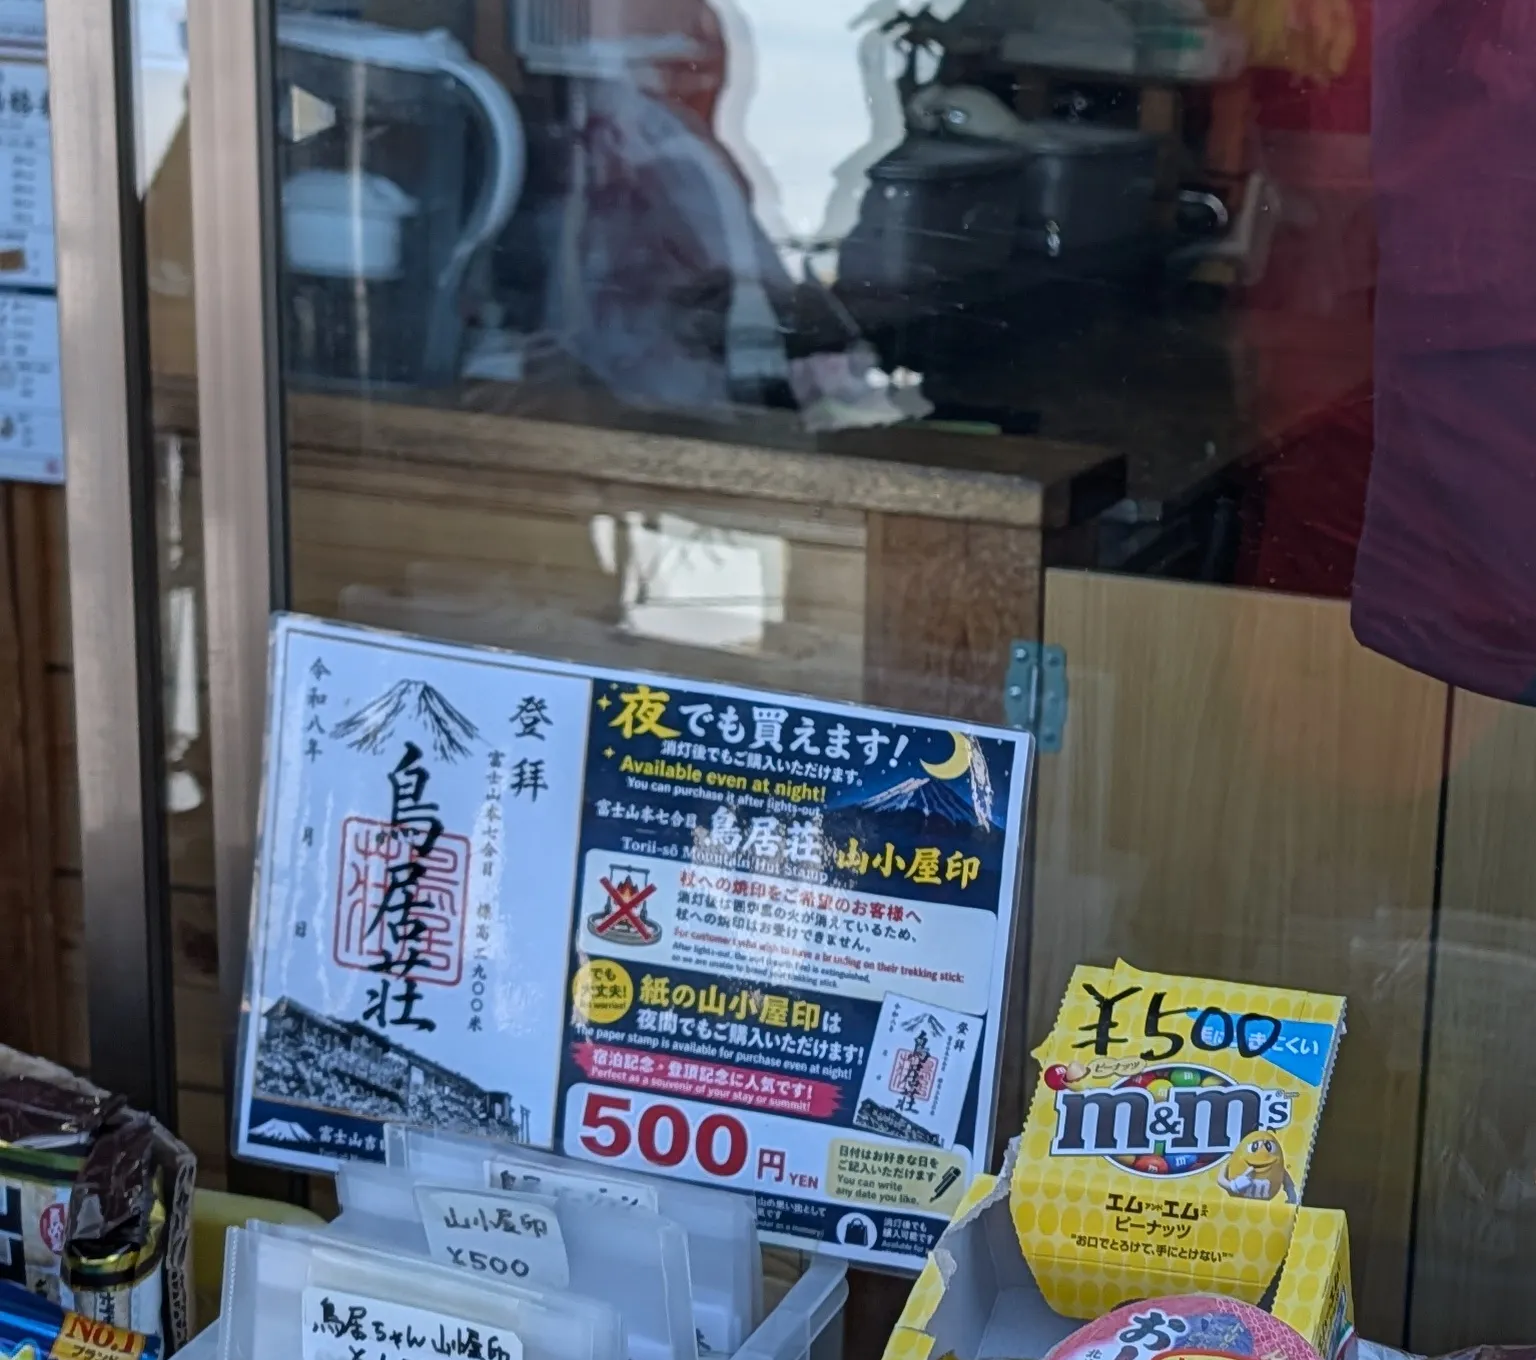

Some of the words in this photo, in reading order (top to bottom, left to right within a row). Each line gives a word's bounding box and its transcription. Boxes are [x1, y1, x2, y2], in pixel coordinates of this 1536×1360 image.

[509, 695, 553, 803] 登拝
[620, 755, 702, 784] Available
[706, 771, 748, 790] even
[752, 776, 770, 793] at
[774, 779, 827, 803] night!
[627, 777, 649, 791] You
[651, 781, 671, 793] can
[673, 783, 724, 803] purchase
[738, 794, 765, 809] after
[705, 805, 825, 864] 鳥居荘
[362, 740, 445, 1034] 鳥居荘
[836, 838, 982, 890] 山小屋印
[1072, 983, 1283, 1062] ¥500
[596, 1029, 626, 1043] paper
[627, 1033, 660, 1049] stamp
[672, 1040, 718, 1058] available
[719, 1044, 735, 1059] for
[736, 1048, 782, 1070] purchase
[784, 1057, 807, 1073] even
[790, 1171, 819, 1190] YEN
[836, 1187, 852, 1199] any
[855, 1188, 876, 1200] date
[879, 1193, 896, 1205] you
[837, 1174, 856, 1186] You
[858, 1179, 875, 1189] can
[878, 1180, 904, 1192] write
[1114, 1216, 1192, 1239] ピーナッツ
